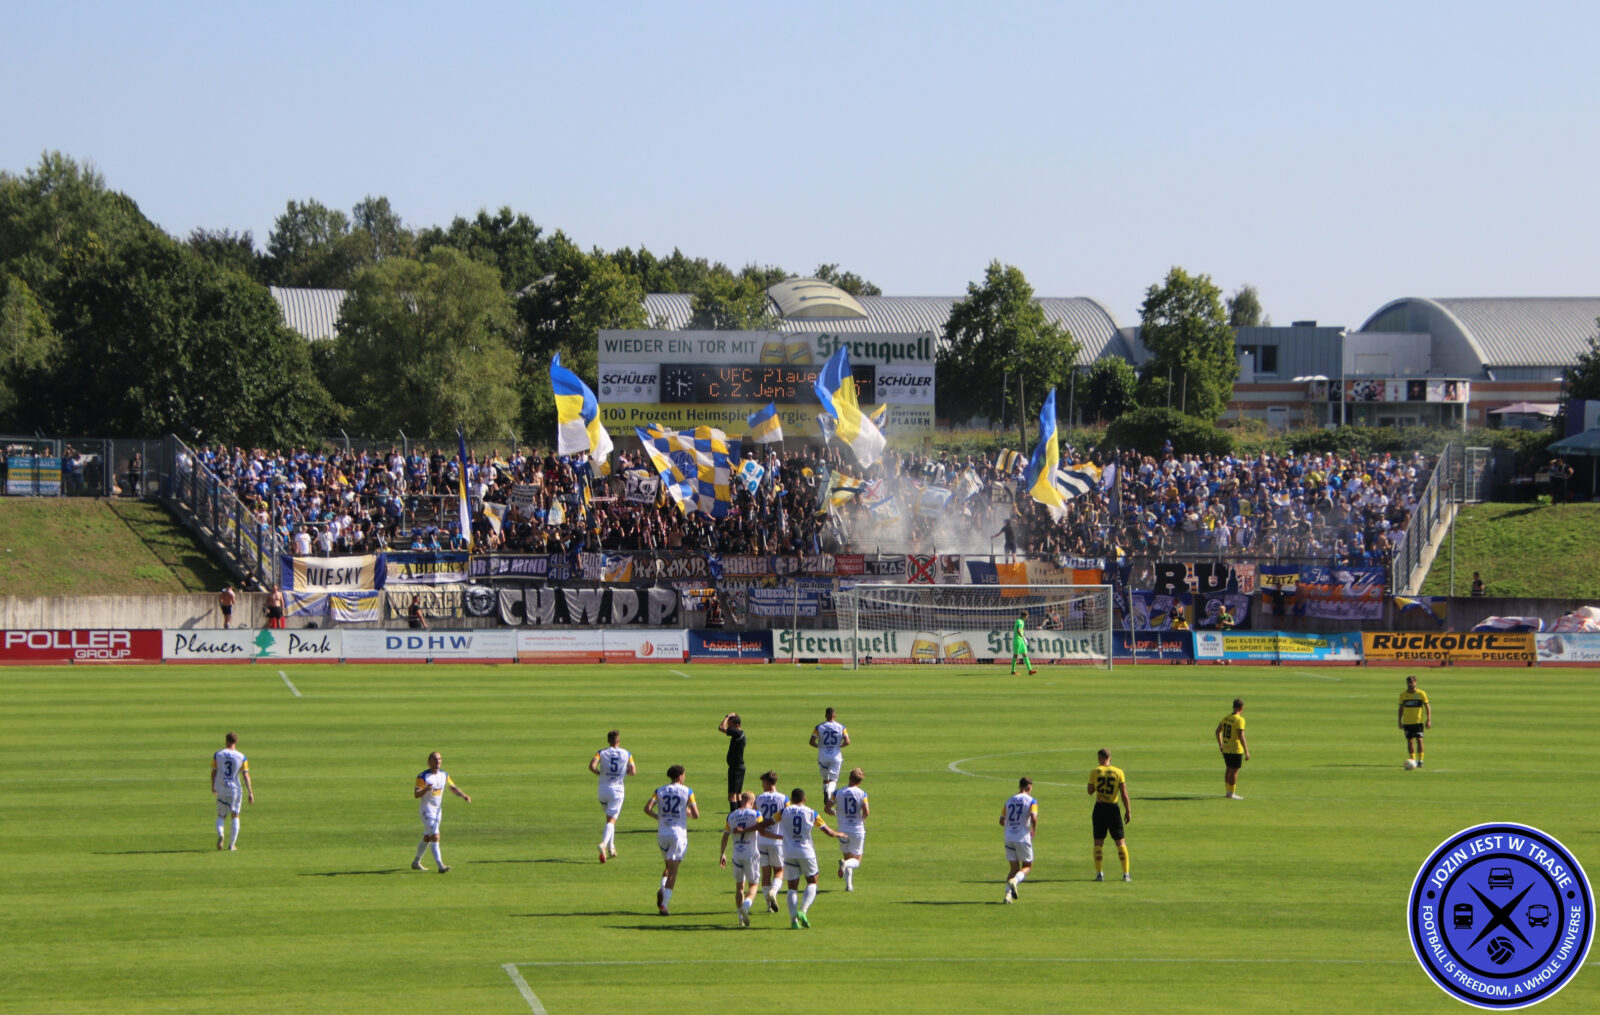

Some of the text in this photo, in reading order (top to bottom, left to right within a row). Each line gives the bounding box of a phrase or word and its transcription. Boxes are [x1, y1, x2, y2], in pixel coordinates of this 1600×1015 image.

[605, 339, 757, 354] WIEDER EIN TOR MIT
[602, 371, 657, 385] SCHÜLER
[720, 367, 820, 383] VFC Plaue
[877, 373, 932, 387] SCHÜLER
[602, 408, 626, 421] 100
[631, 408, 682, 421] Prozent
[891, 418, 930, 426] PLAUEN
[510, 558, 548, 574] MIND
[633, 556, 708, 579] HARAKIR
[306, 567, 362, 586] NIESKY
[1266, 575, 1294, 585] ZEITZ
[389, 591, 462, 609] WOFPACK
[750, 605, 817, 617] UNVERKÄULICH
[5, 631, 131, 649] POLLER
[175, 633, 244, 656] Plauen
[288, 633, 331, 655] Park
[386, 635, 473, 650] DDHW
[987, 629, 1105, 658] Strnquell
[1372, 633, 1499, 650] Rückoldt
[75, 649, 131, 659] GROUP
[1395, 651, 1449, 660] PEUGEOT
[1482, 652, 1536, 661] PEUGEOT
[823, 731, 838, 746] 25
[1222, 723, 1232, 739] 18
[223, 760, 233, 777] 3
[610, 757, 619, 773] 5
[1096, 777, 1115, 794] 25
[662, 795, 681, 814] 32
[844, 797, 857, 815] 13
[1008, 803, 1024, 822] 27
[737, 822, 746, 841] 7
[792, 815, 802, 835] 9
